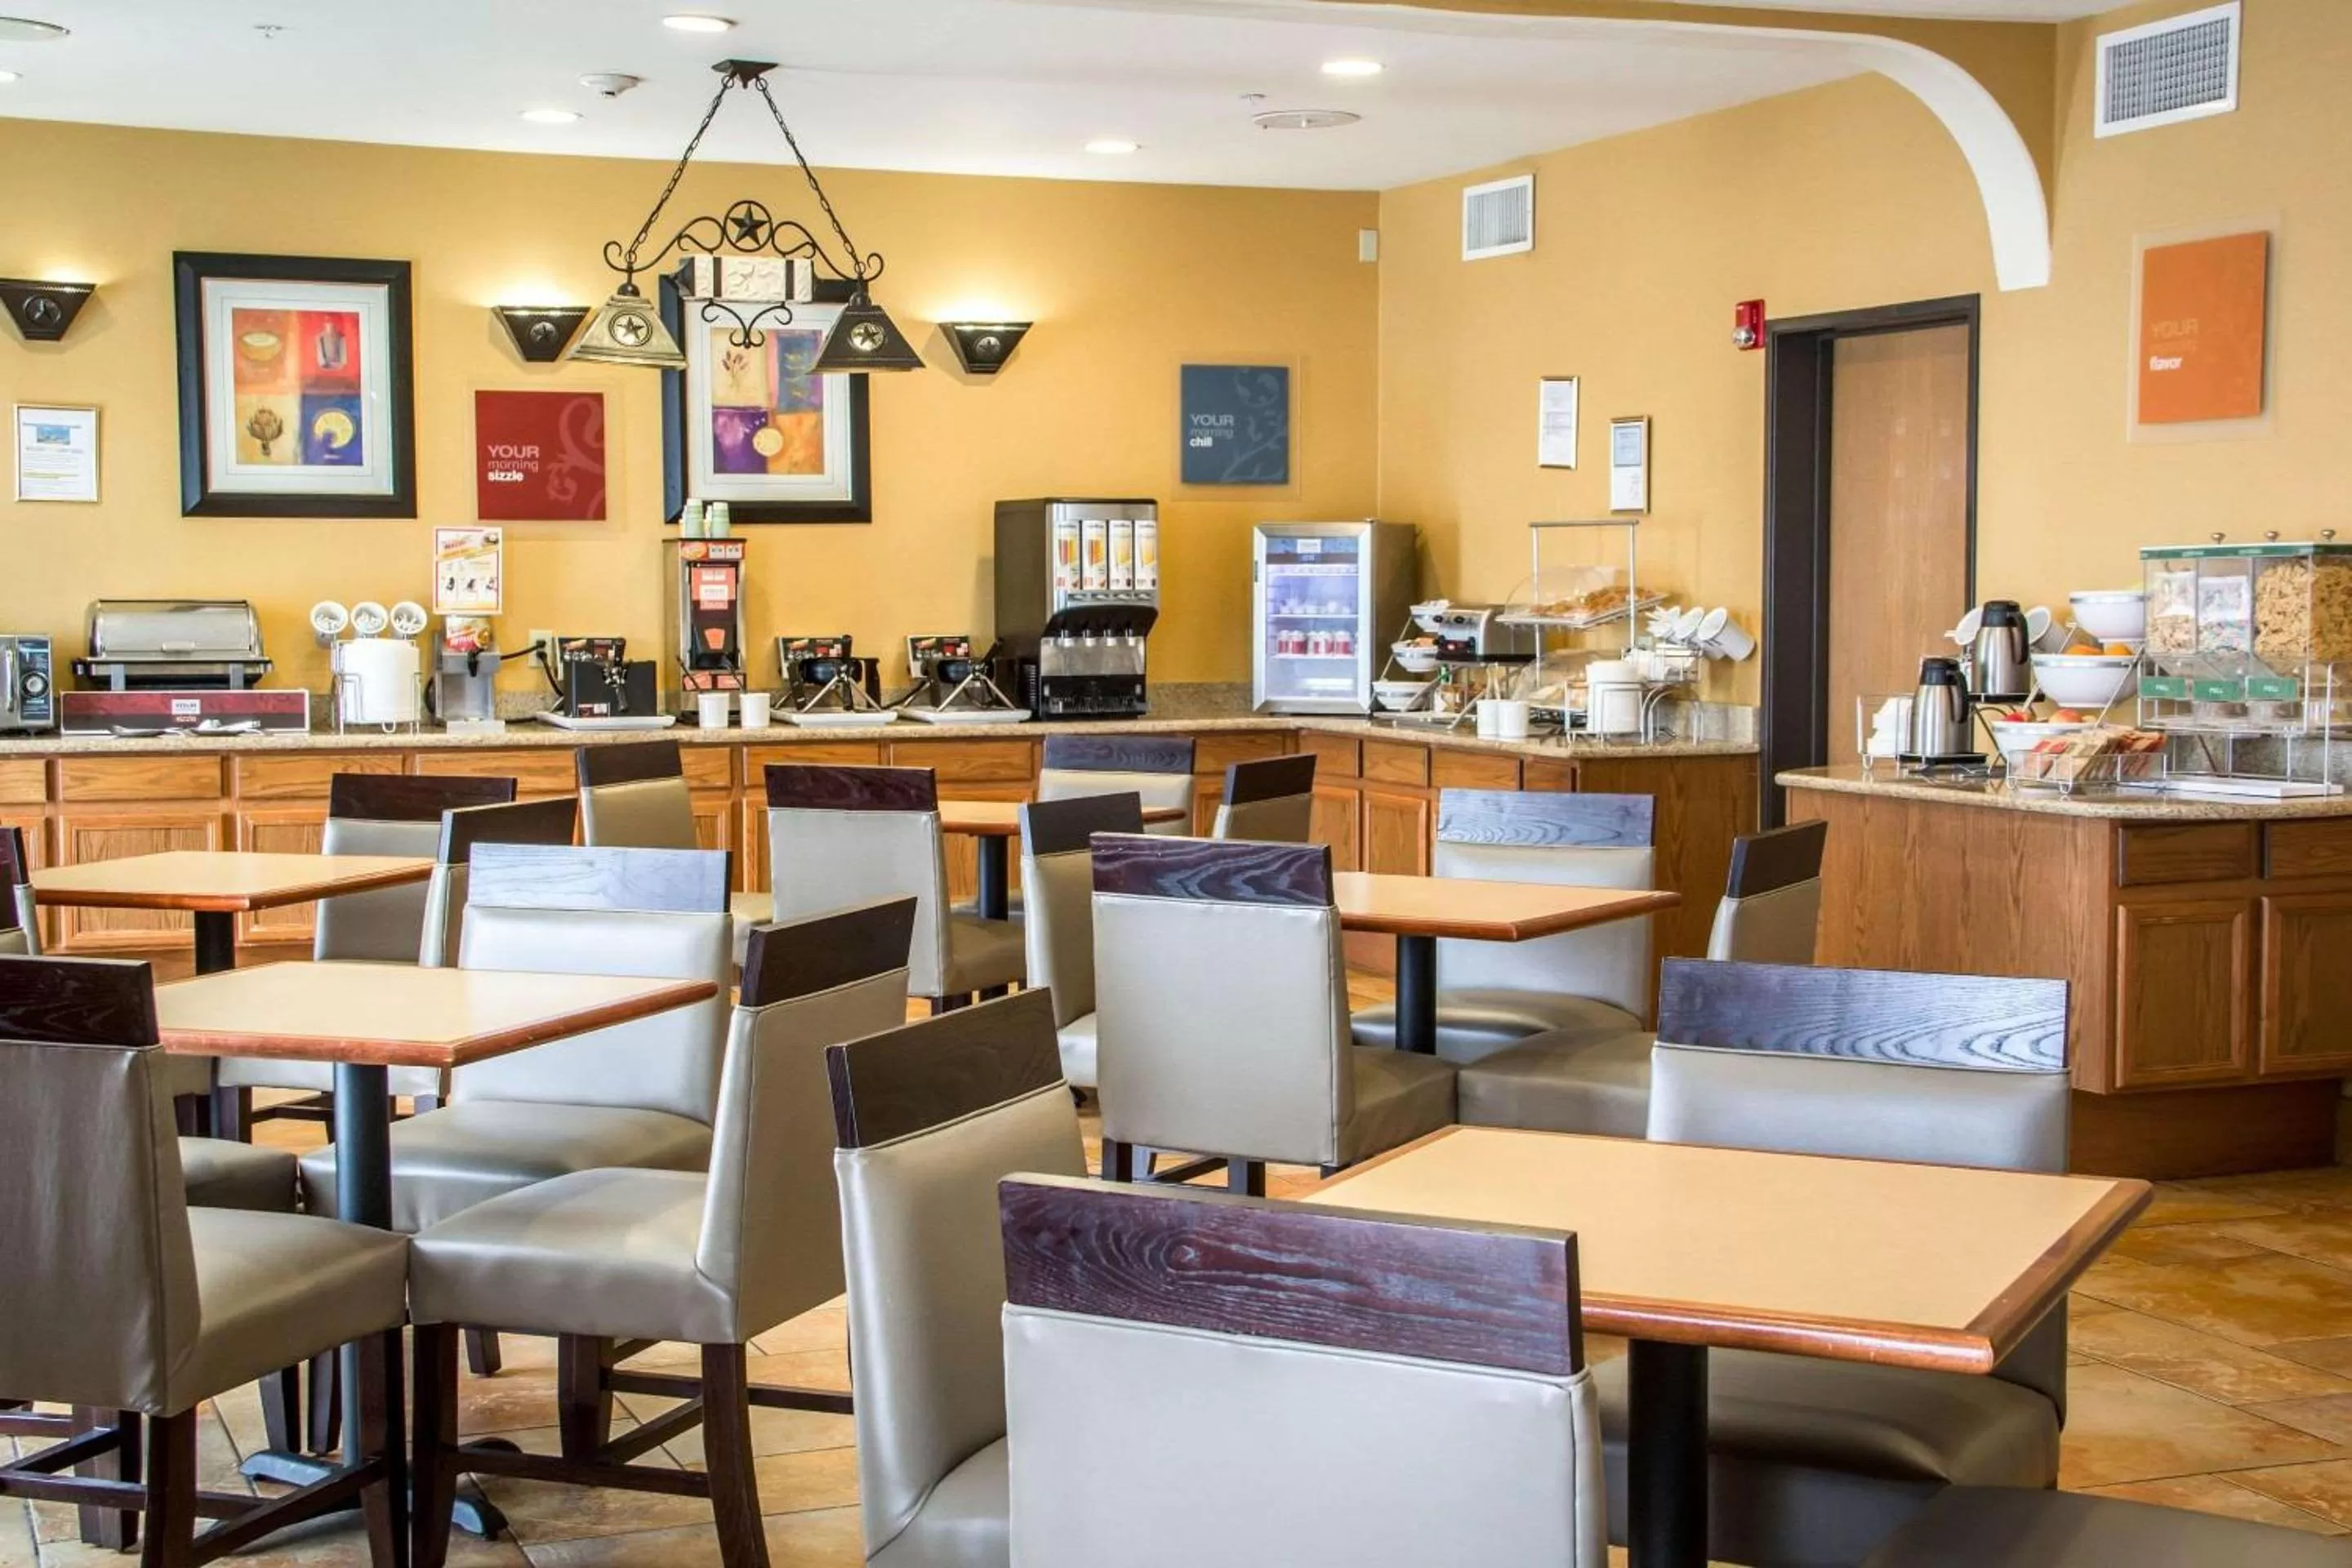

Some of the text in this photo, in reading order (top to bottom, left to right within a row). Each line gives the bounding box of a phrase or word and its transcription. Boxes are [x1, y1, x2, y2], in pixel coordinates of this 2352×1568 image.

[1189, 414, 1234, 426] YOUR
[1189, 436, 1213, 448] chill
[488, 444, 540, 458] YOUR
[488, 459, 539, 474] morning
[488, 470, 524, 482] sizzle
